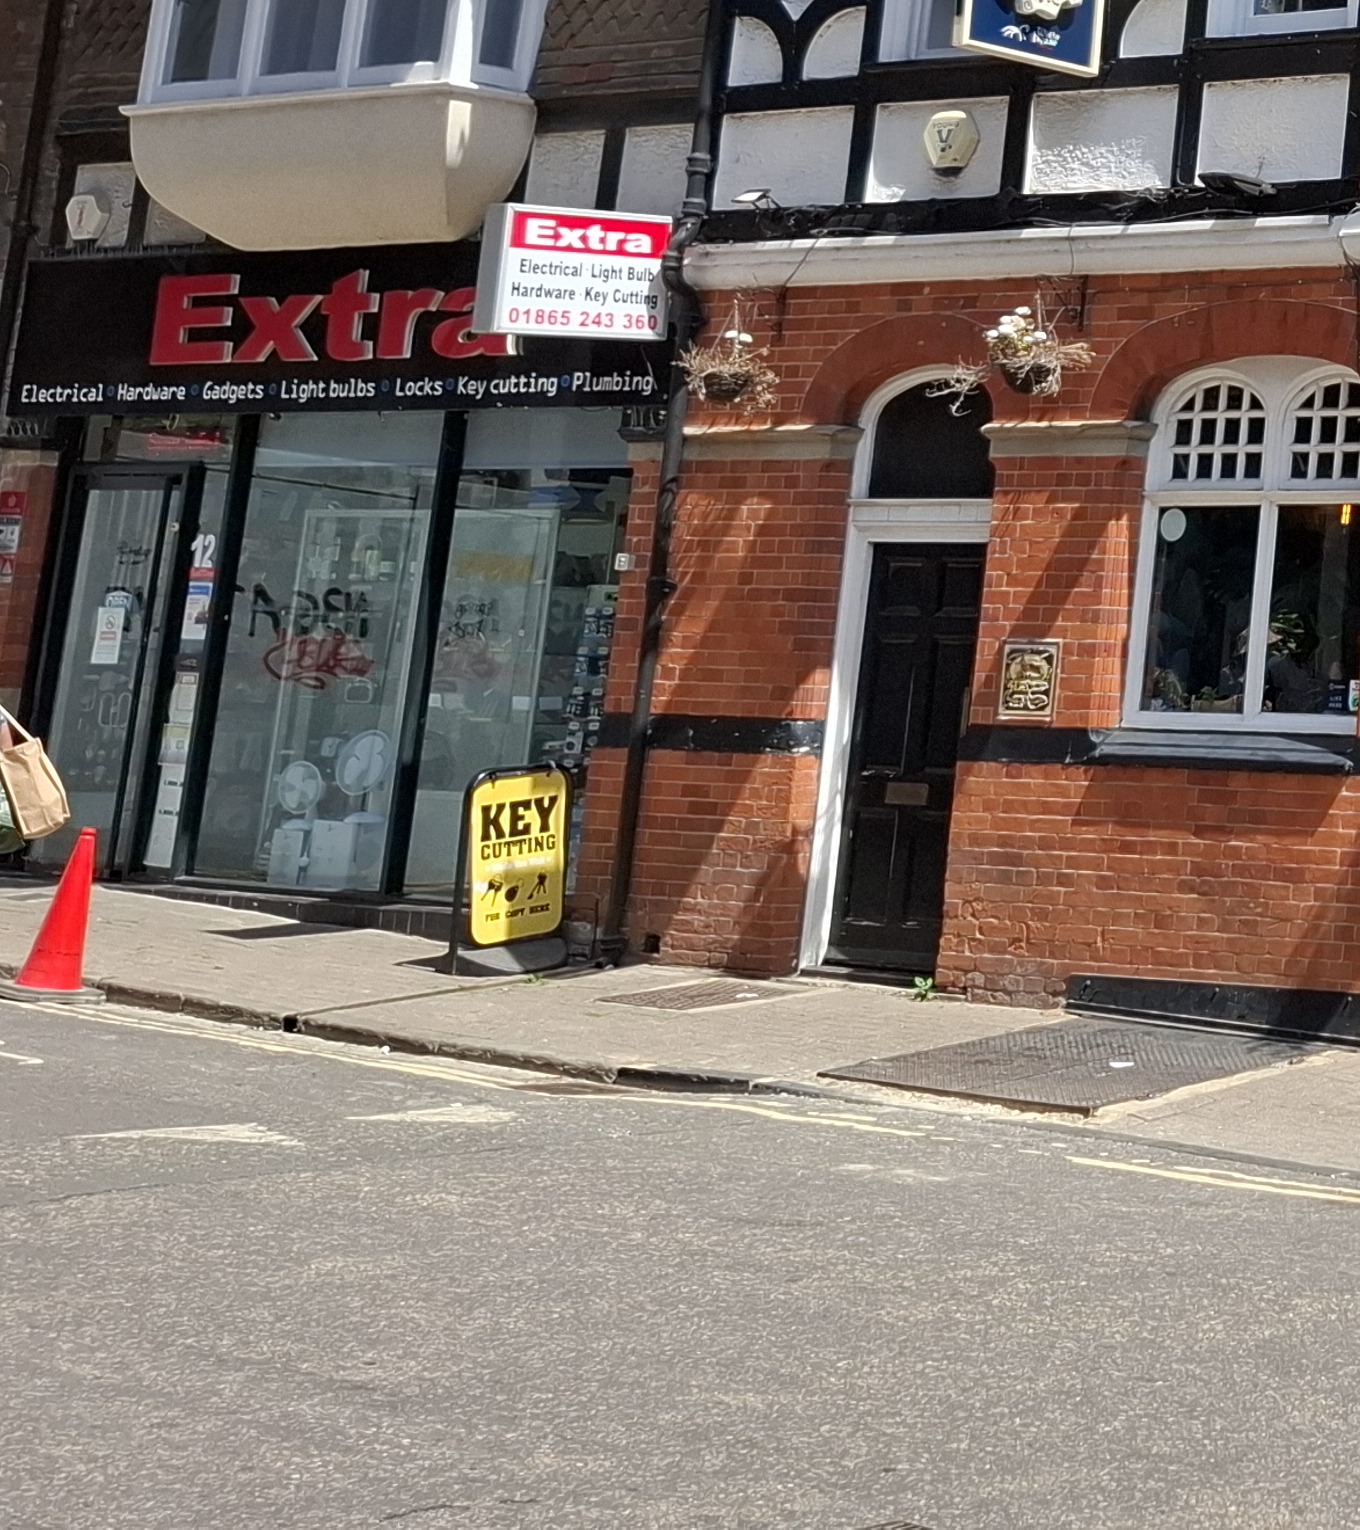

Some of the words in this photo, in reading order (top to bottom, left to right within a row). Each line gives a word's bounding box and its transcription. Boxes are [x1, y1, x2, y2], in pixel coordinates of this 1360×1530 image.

[525, 217, 652, 254] Extra
[519, 258, 583, 278] Electrical
[591, 262, 624, 284] Light
[627, 266, 656, 283] Bulb
[511, 281, 576, 301] Hardware
[585, 286, 609, 307] Key
[613, 288, 659, 310] Cutting
[149, 267, 525, 366] Extra
[509, 307, 571, 326] 01865
[579, 311, 615, 329] 243
[622, 313, 659, 332] 360
[21, 383, 104, 403] Electrical
[116, 381, 187, 402] Hardware
[203, 381, 265, 405] Gadgets
[280, 379, 328, 403] Light
[330, 376, 376, 398] bulbs
[395, 375, 444, 397] Locks
[457, 376, 486, 400] Key
[490, 374, 558, 398] cutting
[571, 371, 654, 396] Plumbing
[190, 534, 216, 568] 12
[480, 795, 559, 843] KEY
[480, 833, 556, 861] CUTTING
